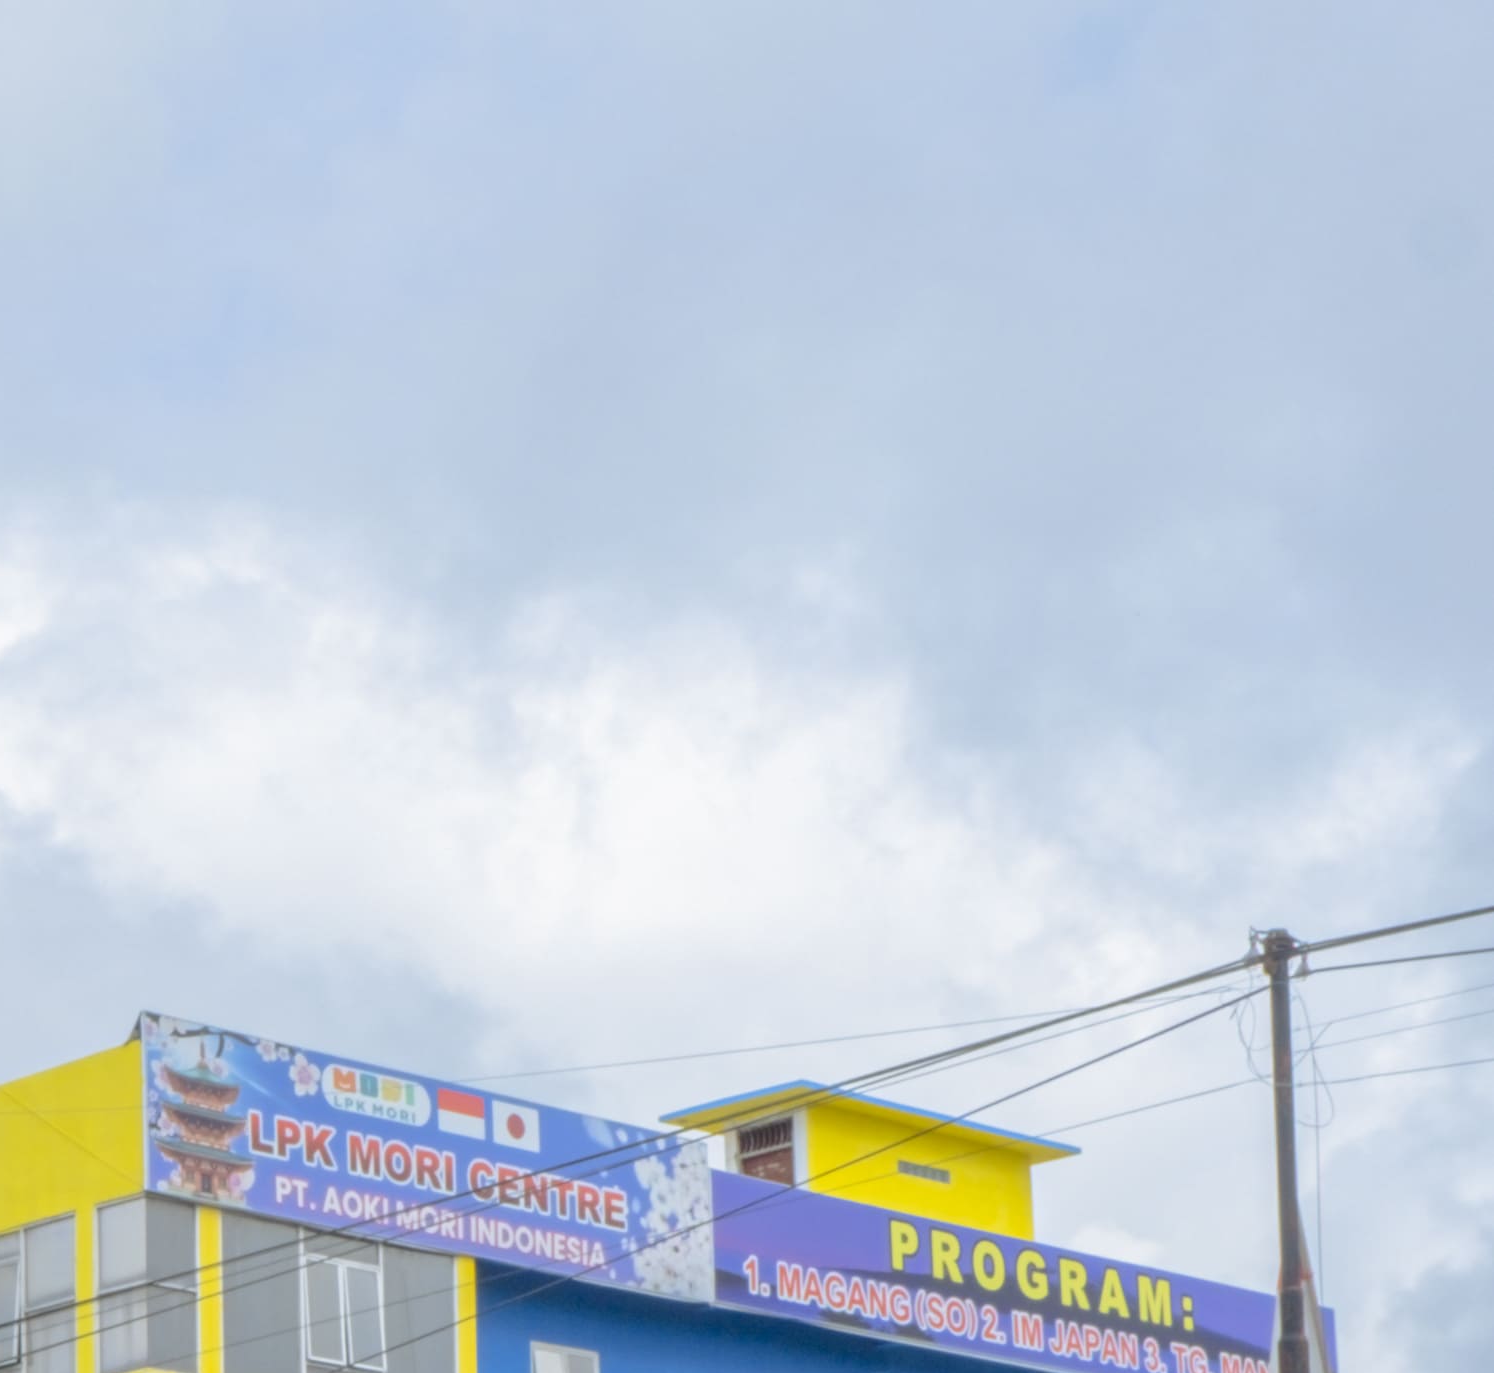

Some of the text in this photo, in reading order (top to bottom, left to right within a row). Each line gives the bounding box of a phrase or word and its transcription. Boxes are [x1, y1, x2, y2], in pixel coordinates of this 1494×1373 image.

[333, 1095, 417, 1124] LPK MORI
[248, 1109, 628, 1232] LPK MORI CENTRE
[275, 1175, 607, 1269] PT. AOKI MORI INDONESIA
[743, 1255, 770, 1296] 1.
[776, 1261, 911, 1325] MAGANG
[915, 1288, 978, 1340] (SO)
[981, 1305, 1007, 1344] 2.
[1012, 1310, 1044, 1351] IM
[1049, 1320, 1140, 1371] JAPAN
[889, 1219, 1195, 1332] PROGRAM:
